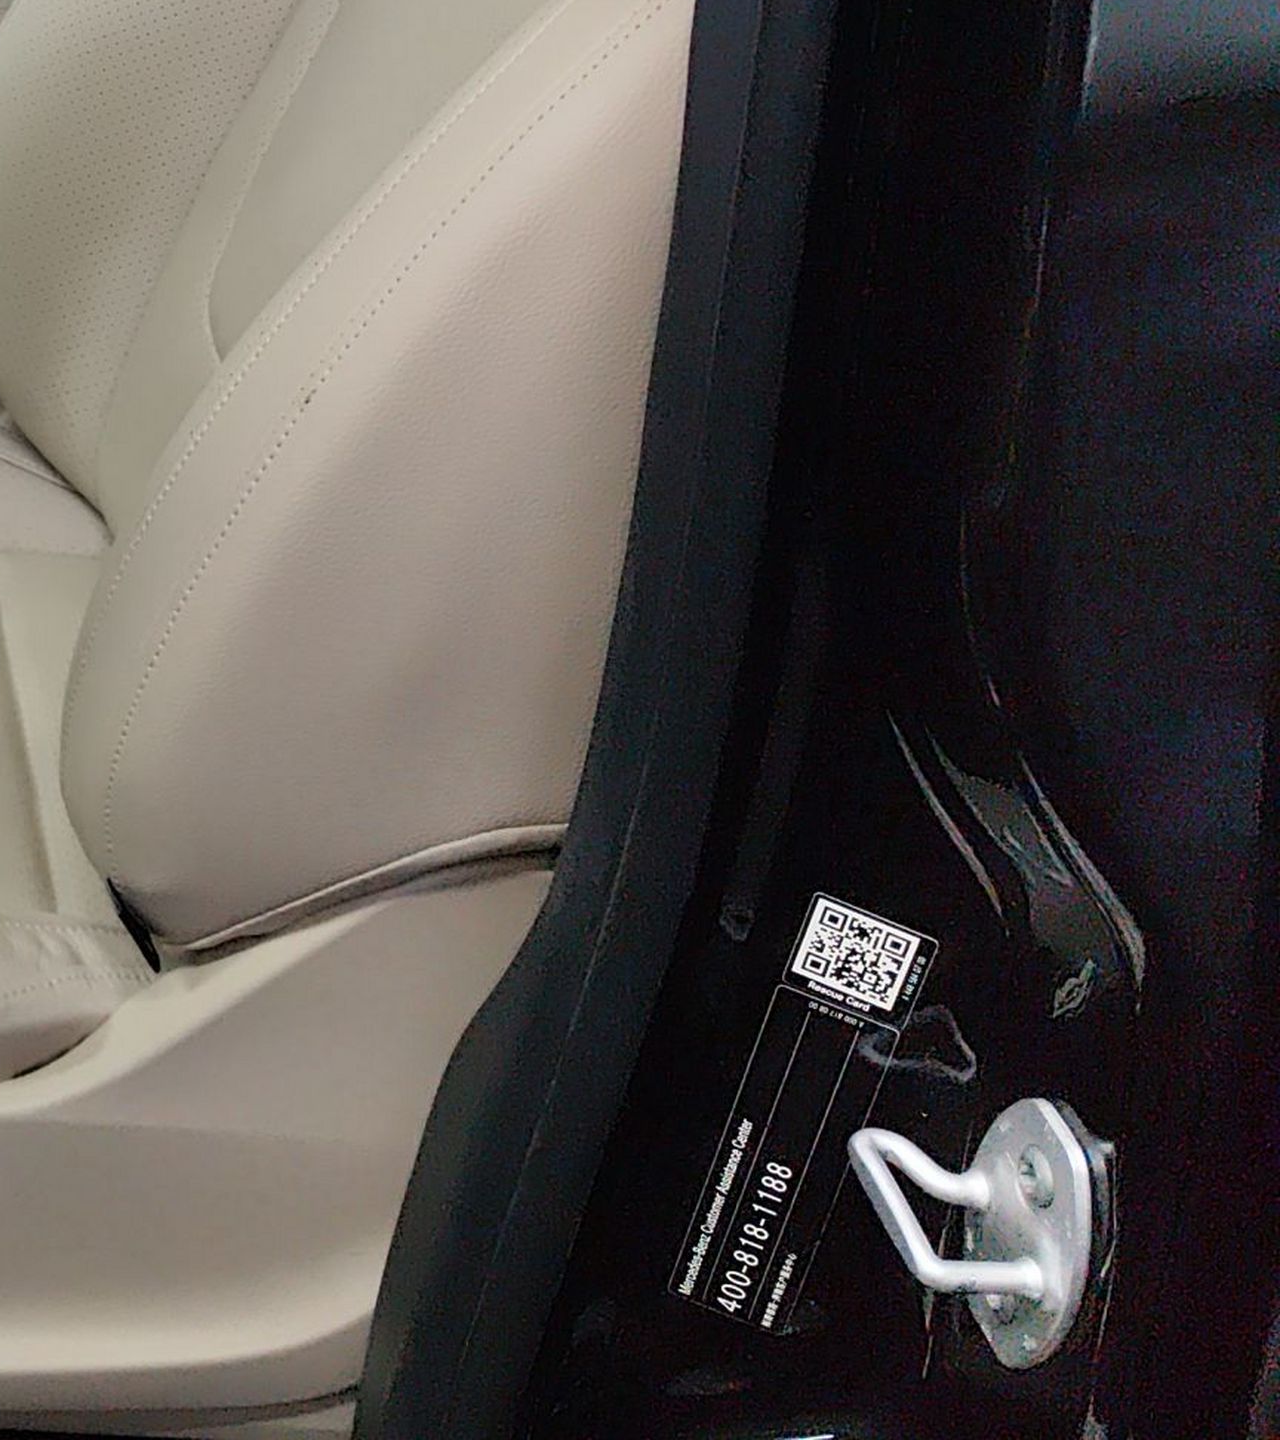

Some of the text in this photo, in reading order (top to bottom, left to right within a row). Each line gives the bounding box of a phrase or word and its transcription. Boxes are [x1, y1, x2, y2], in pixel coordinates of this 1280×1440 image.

[808, 980, 870, 1013] Rescue Card
[679, 1118, 753, 1296] Mercedes-Benz Customer Assistance Center
[717, 1162, 793, 1312] 400-818-1188
